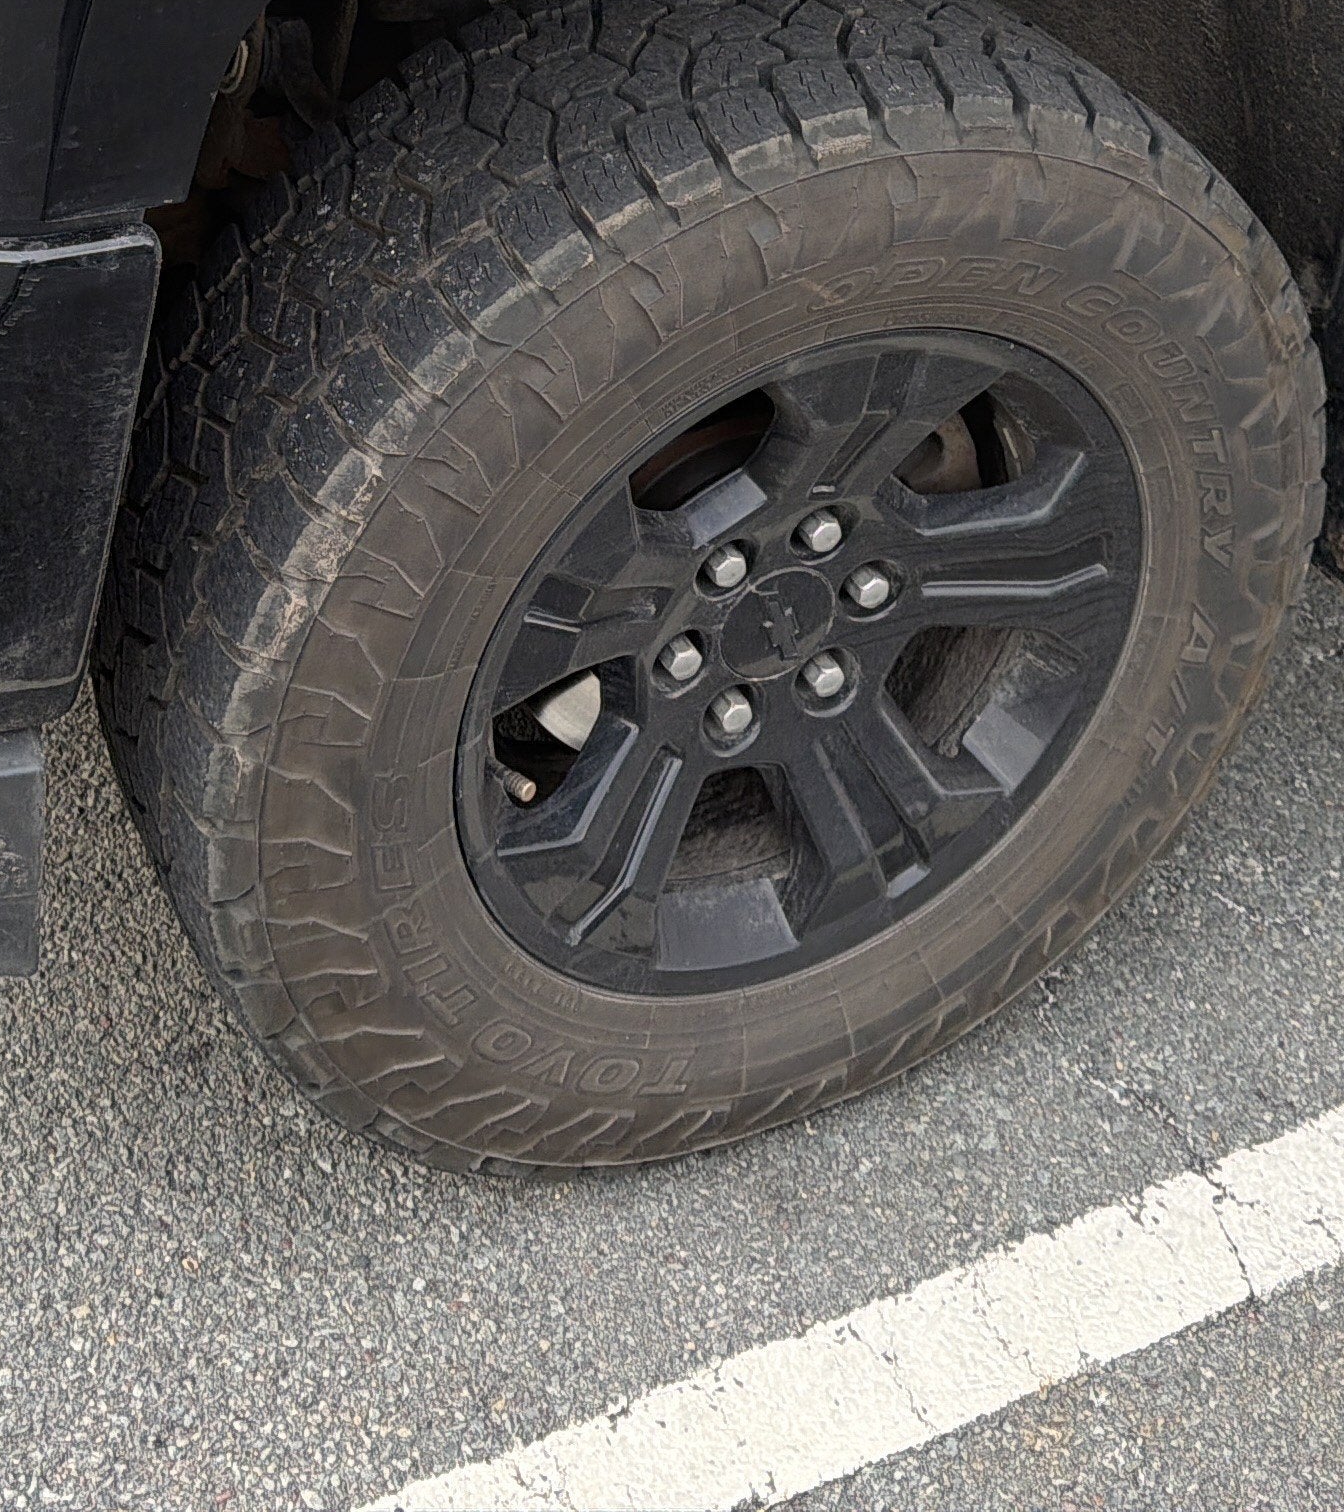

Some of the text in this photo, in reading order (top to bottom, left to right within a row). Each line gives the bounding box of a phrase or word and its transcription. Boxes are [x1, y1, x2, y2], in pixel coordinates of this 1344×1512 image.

[808, 257, 1060, 311] OPEN
[1063, 285, 1236, 567] COUNTRY
[370, 773, 690, 1094] TOYO TIRES
